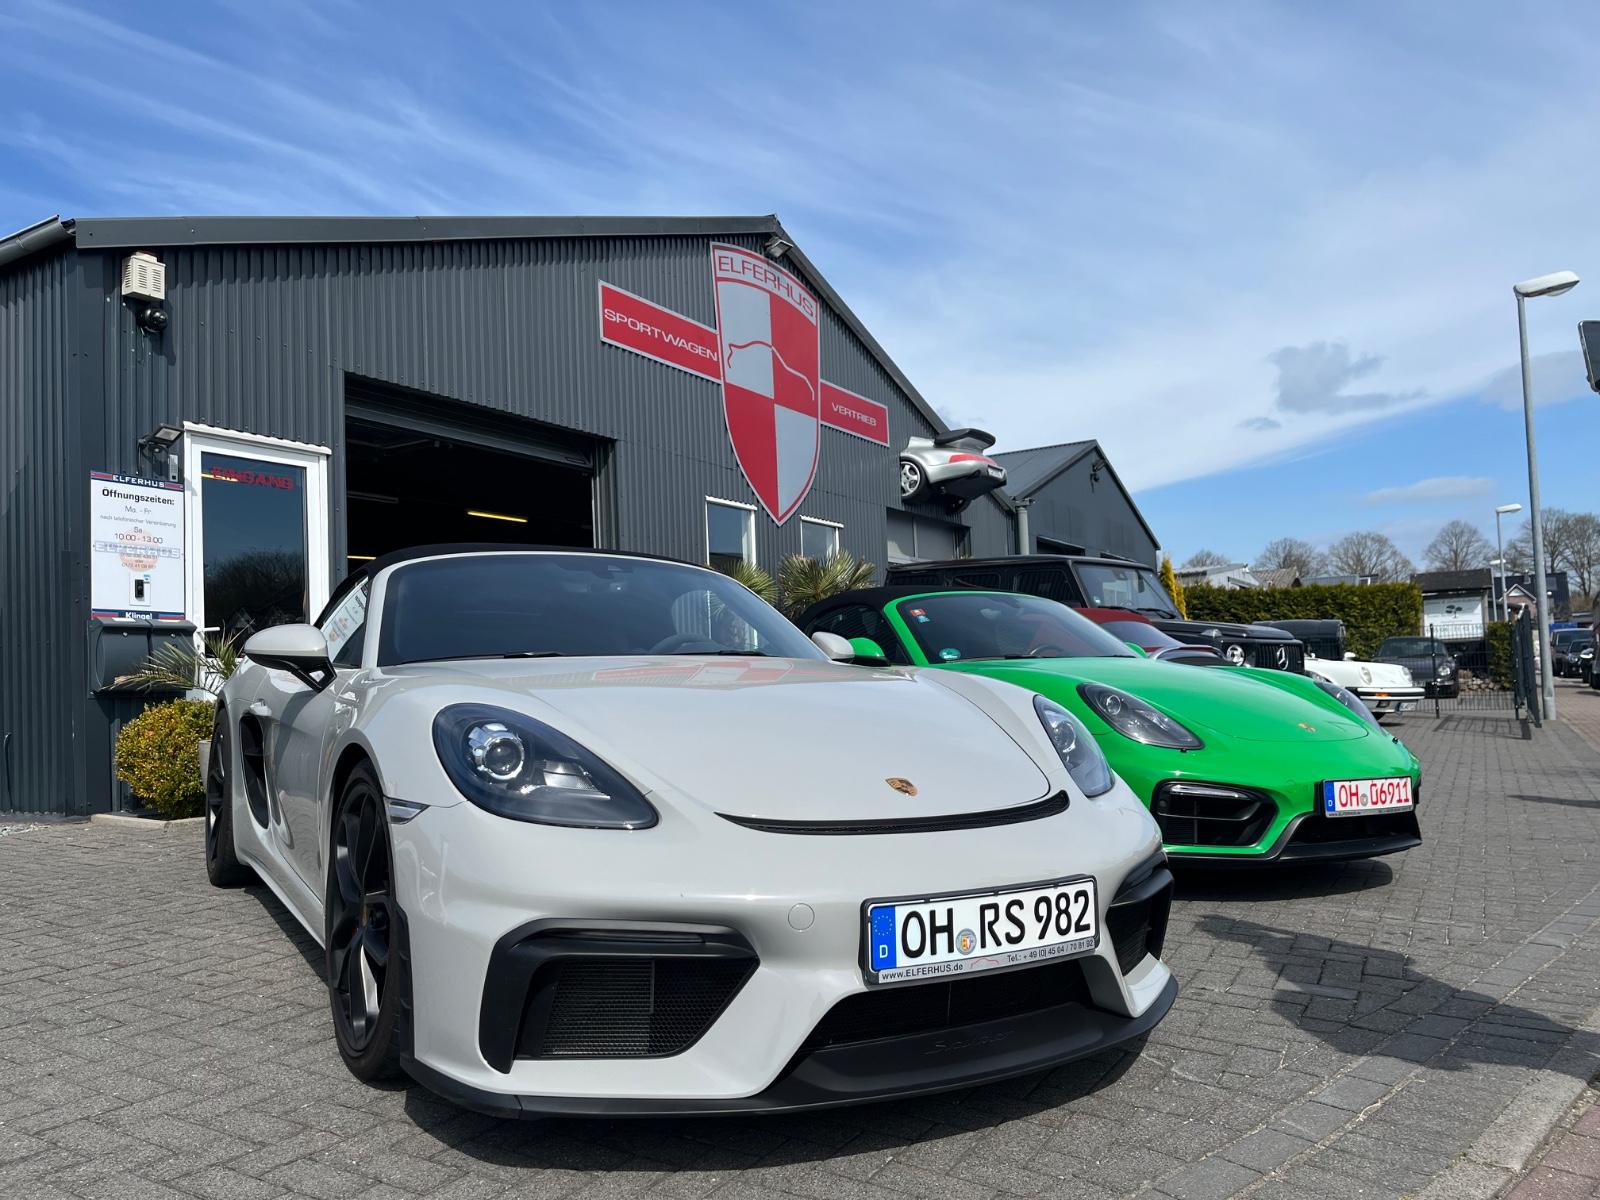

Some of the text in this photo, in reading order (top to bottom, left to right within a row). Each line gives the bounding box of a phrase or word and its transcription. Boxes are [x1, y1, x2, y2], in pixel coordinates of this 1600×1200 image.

[717, 255, 816, 318] ELFERHUS
[604, 308, 718, 362] SPORTWAGEN
[831, 402, 877, 427] VERTRIEB
[112, 474, 165, 488] ELFERHUS
[102, 486, 175, 506] Öffnungszeiten:
[125, 611, 153, 620] Klingel
[1338, 781, 1410, 808] OH 06911
[901, 889, 1091, 959] OH RS 982
[879, 944, 889, 959] D
[1007, 954, 1021, 962] Tel.:
[1048, 947, 1056, 955] 45
[882, 963, 964, 980] www.ELFERHUS.de
